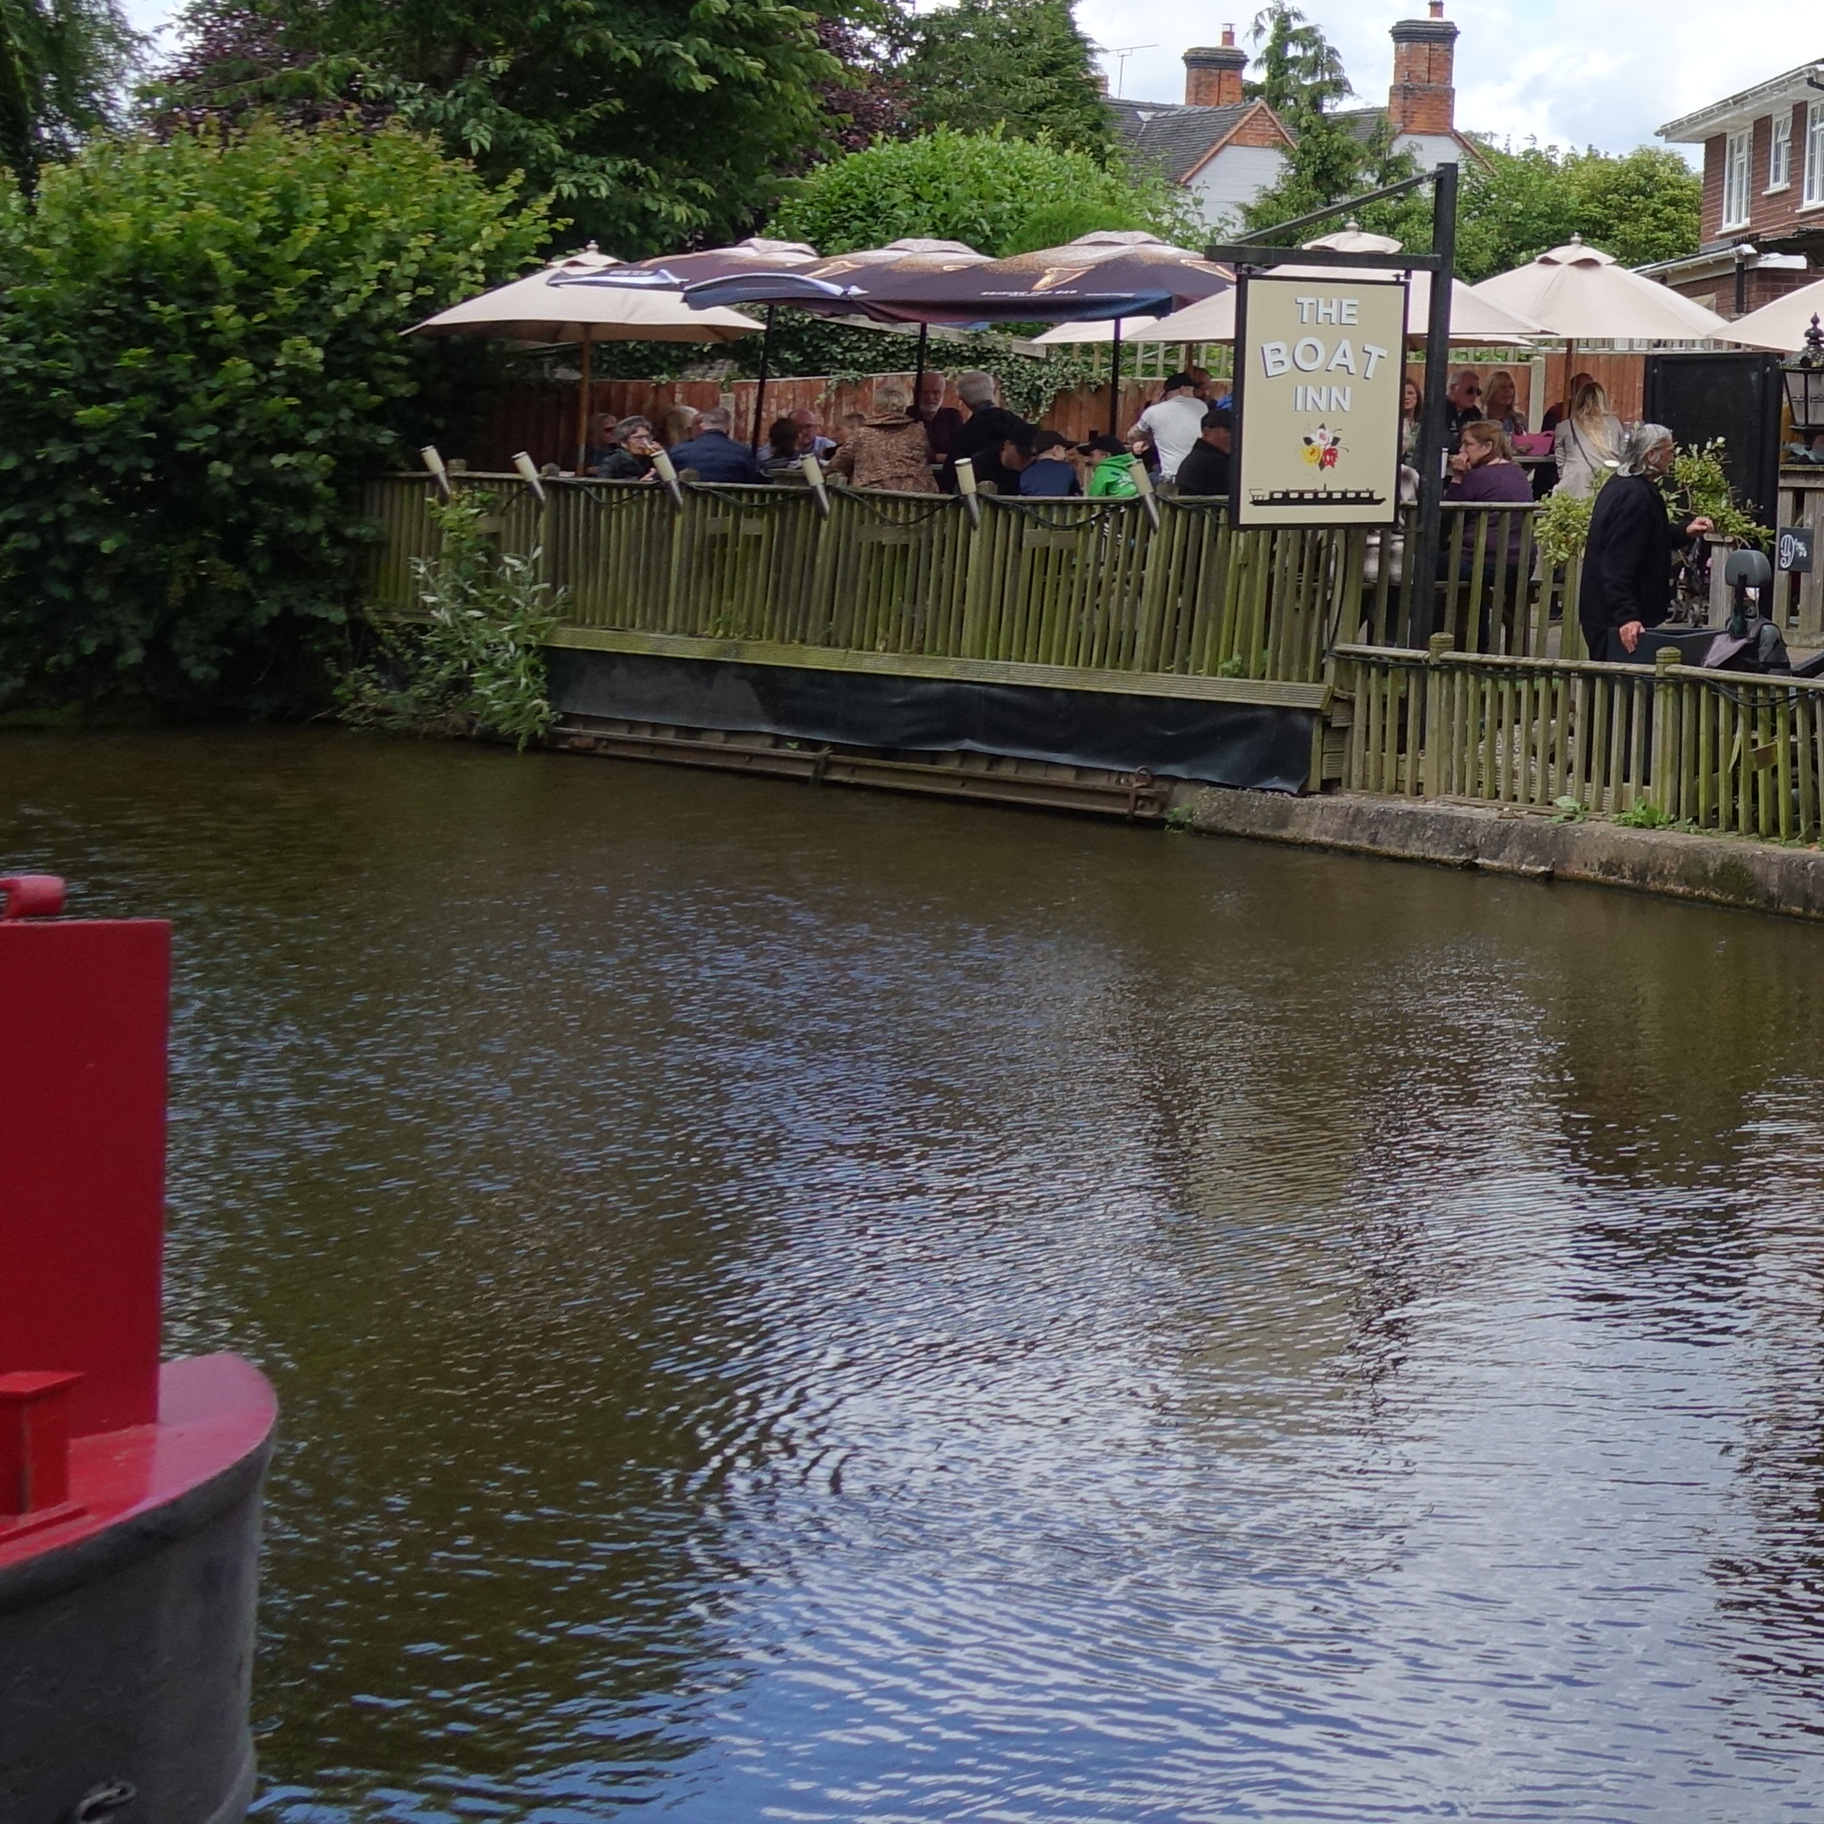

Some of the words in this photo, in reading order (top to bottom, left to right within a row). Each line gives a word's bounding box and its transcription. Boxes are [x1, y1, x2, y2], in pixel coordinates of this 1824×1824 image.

[1295, 296, 1359, 326] THE
[1261, 336, 1388, 380] BOAT
[1294, 385, 1351, 412] INN
